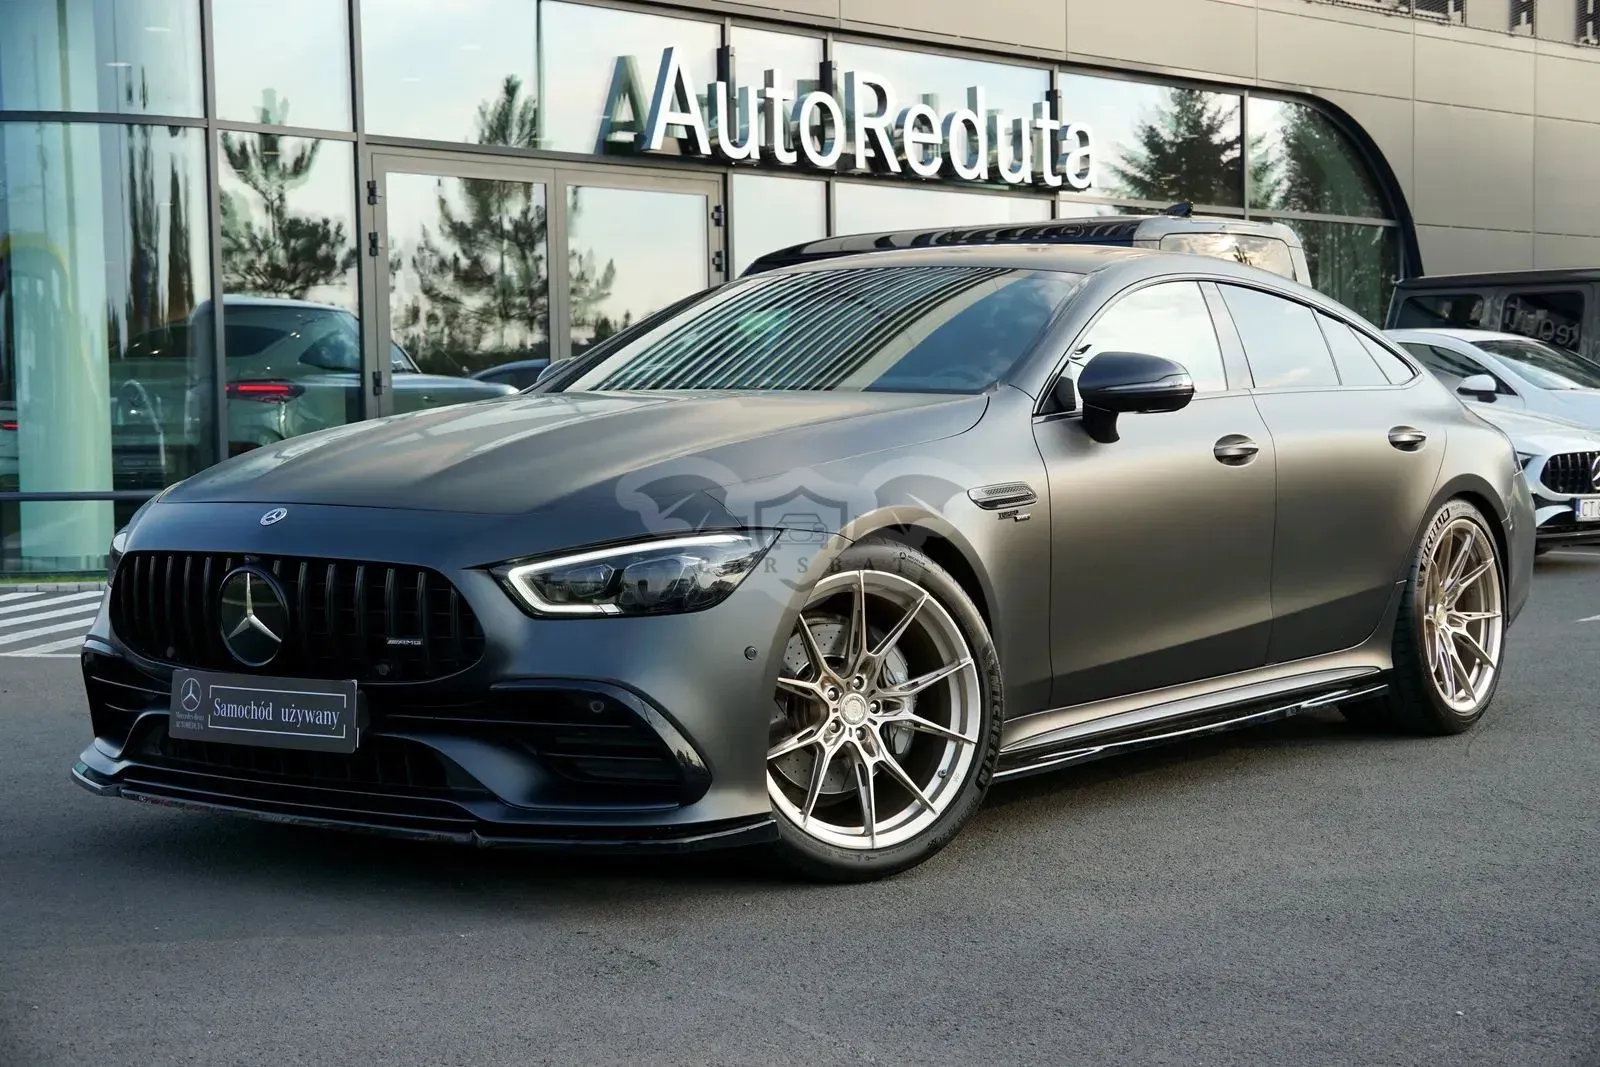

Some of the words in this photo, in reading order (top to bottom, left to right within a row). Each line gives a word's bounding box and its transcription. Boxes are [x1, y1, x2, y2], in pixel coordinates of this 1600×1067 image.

[645, 46, 1097, 189] AutoReduta
[213, 697, 273, 720] Samochód
[281, 704, 340, 730] używany
[979, 674, 1001, 785] MICHELIN
